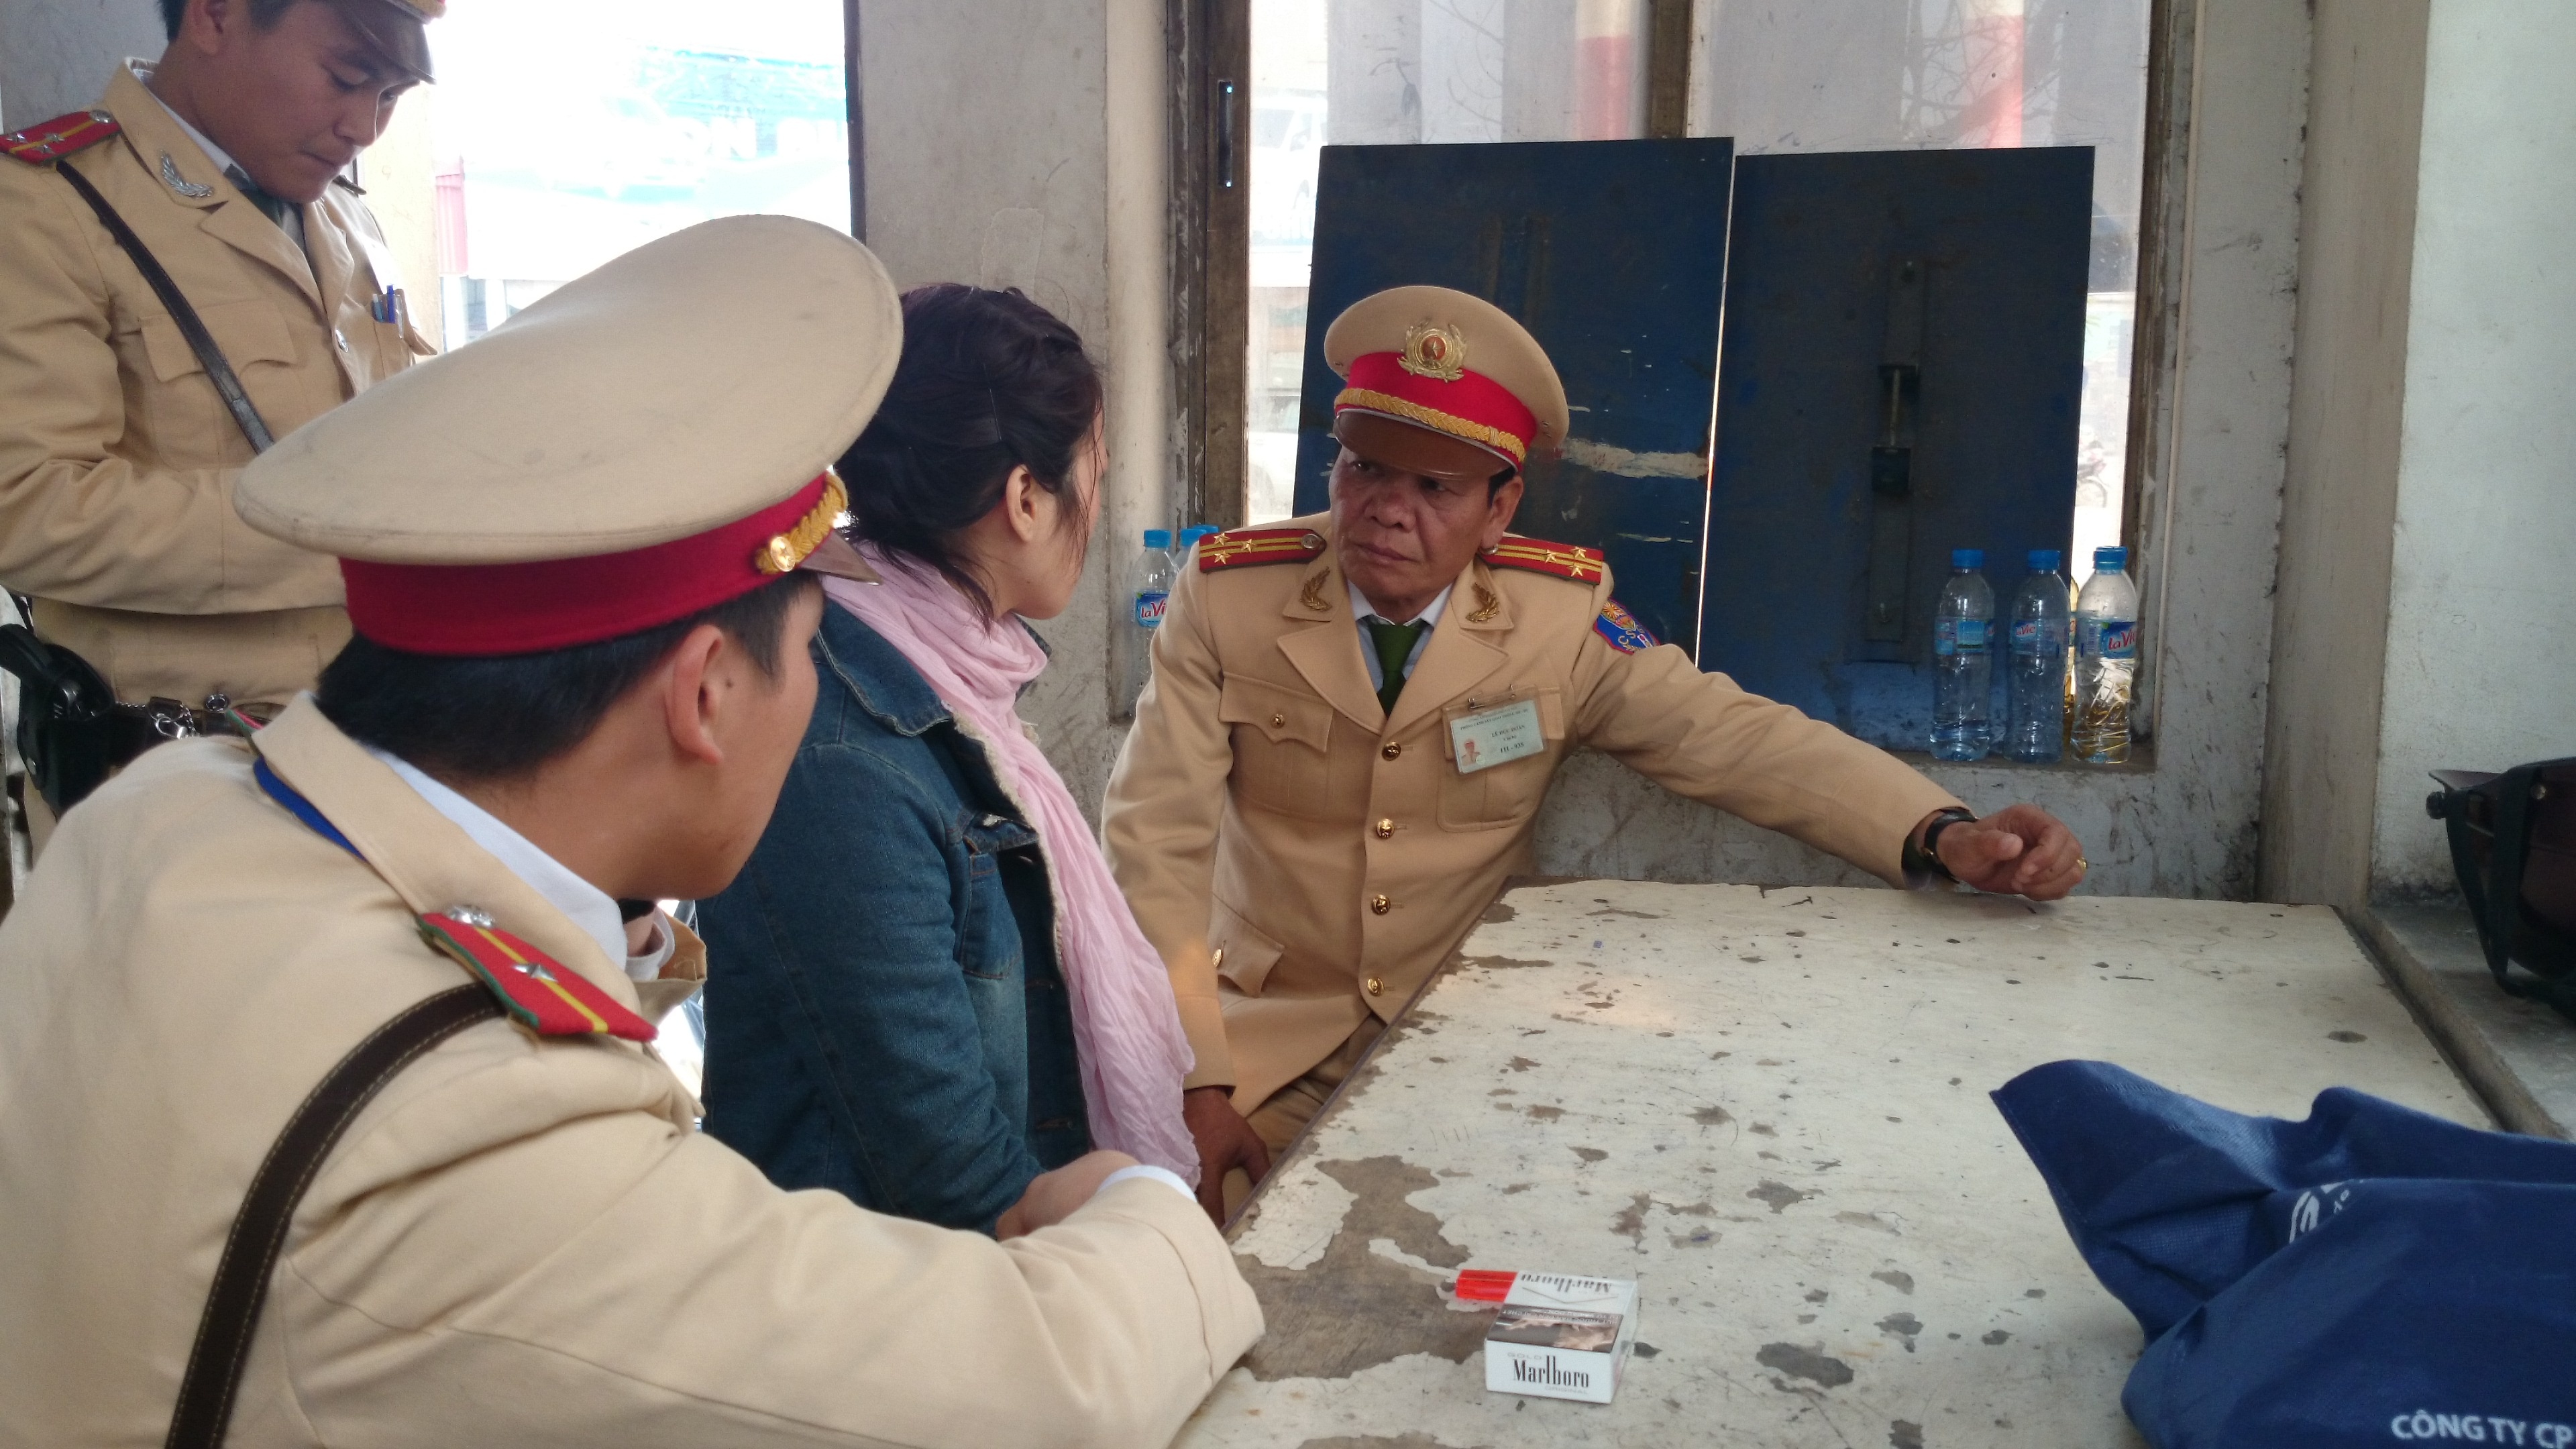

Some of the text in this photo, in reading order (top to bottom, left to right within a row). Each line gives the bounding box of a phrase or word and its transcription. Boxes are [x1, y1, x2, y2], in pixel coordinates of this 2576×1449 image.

[1521, 1274, 1611, 1293] Marlboro
[1507, 1352, 1542, 1360] GOLD
[1513, 1355, 1589, 1388] Marlboro
[2391, 1409, 2574, 1449] CÔNG TY CP
